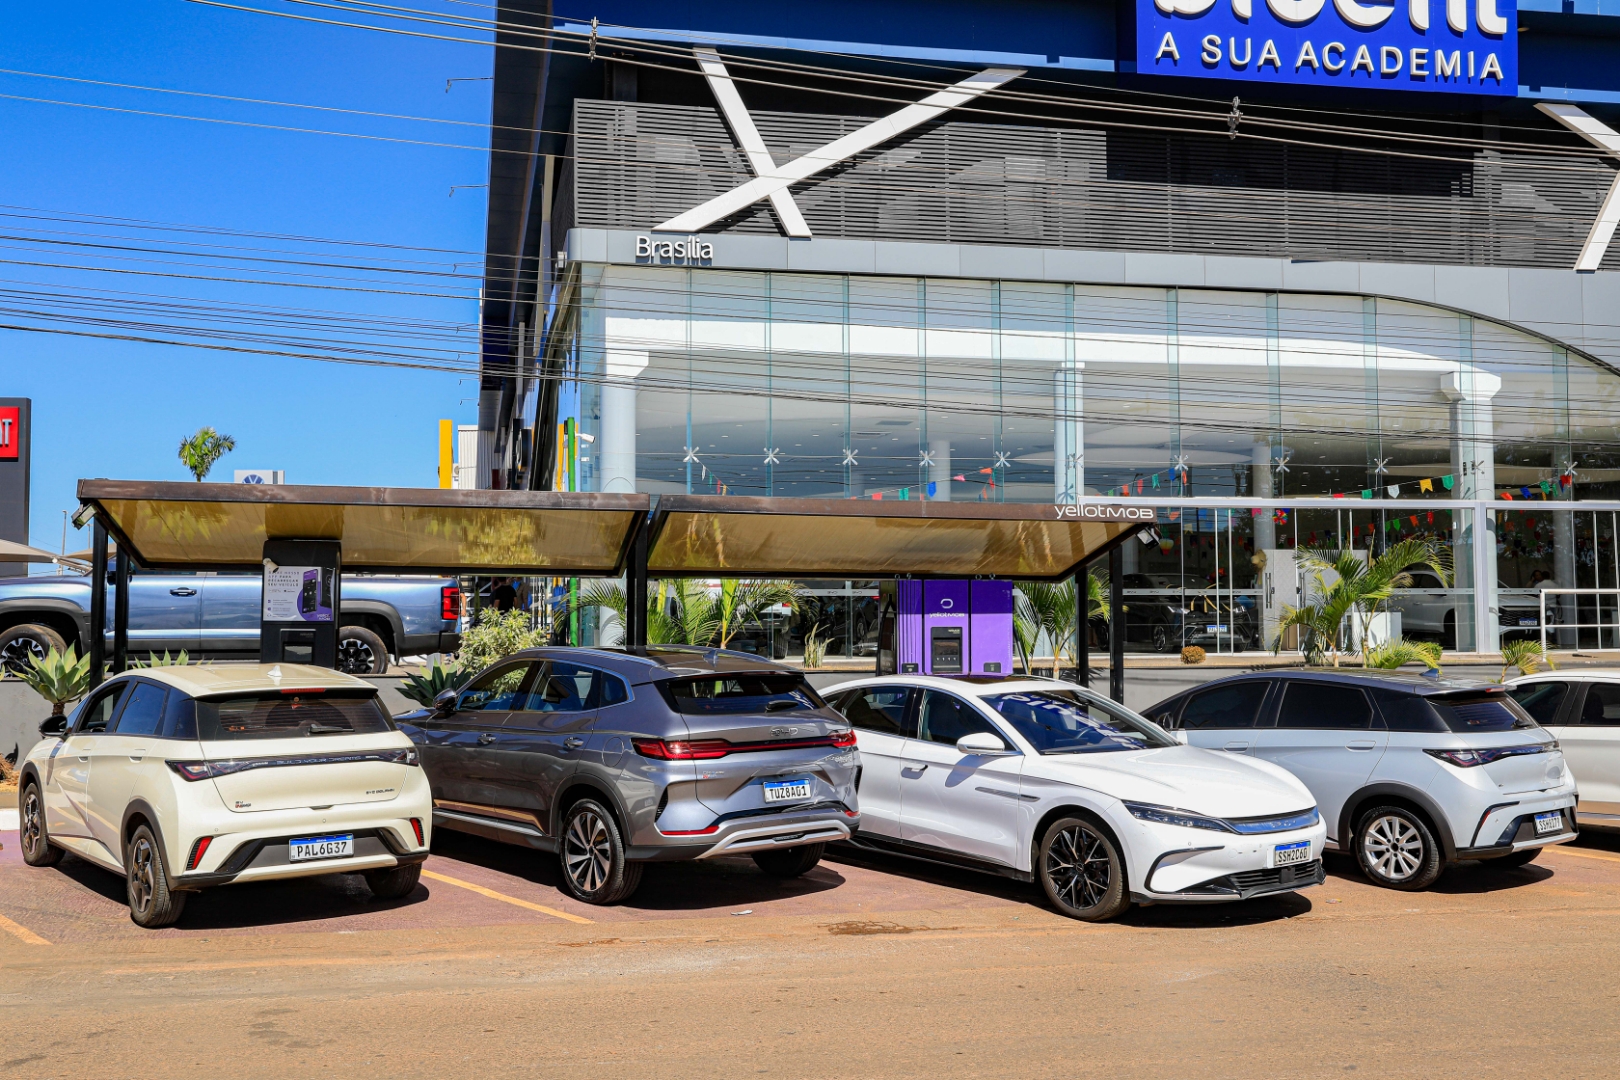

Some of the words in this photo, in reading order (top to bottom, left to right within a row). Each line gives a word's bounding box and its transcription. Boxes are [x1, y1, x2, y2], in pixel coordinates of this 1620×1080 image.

[1155, 31, 1180, 61] A
[1201, 34, 1282, 68] SUA
[1295, 40, 1504, 81] ACADEMIA
[635, 234, 714, 259] Brasília
[296, 841, 347, 858] PAL6G37
